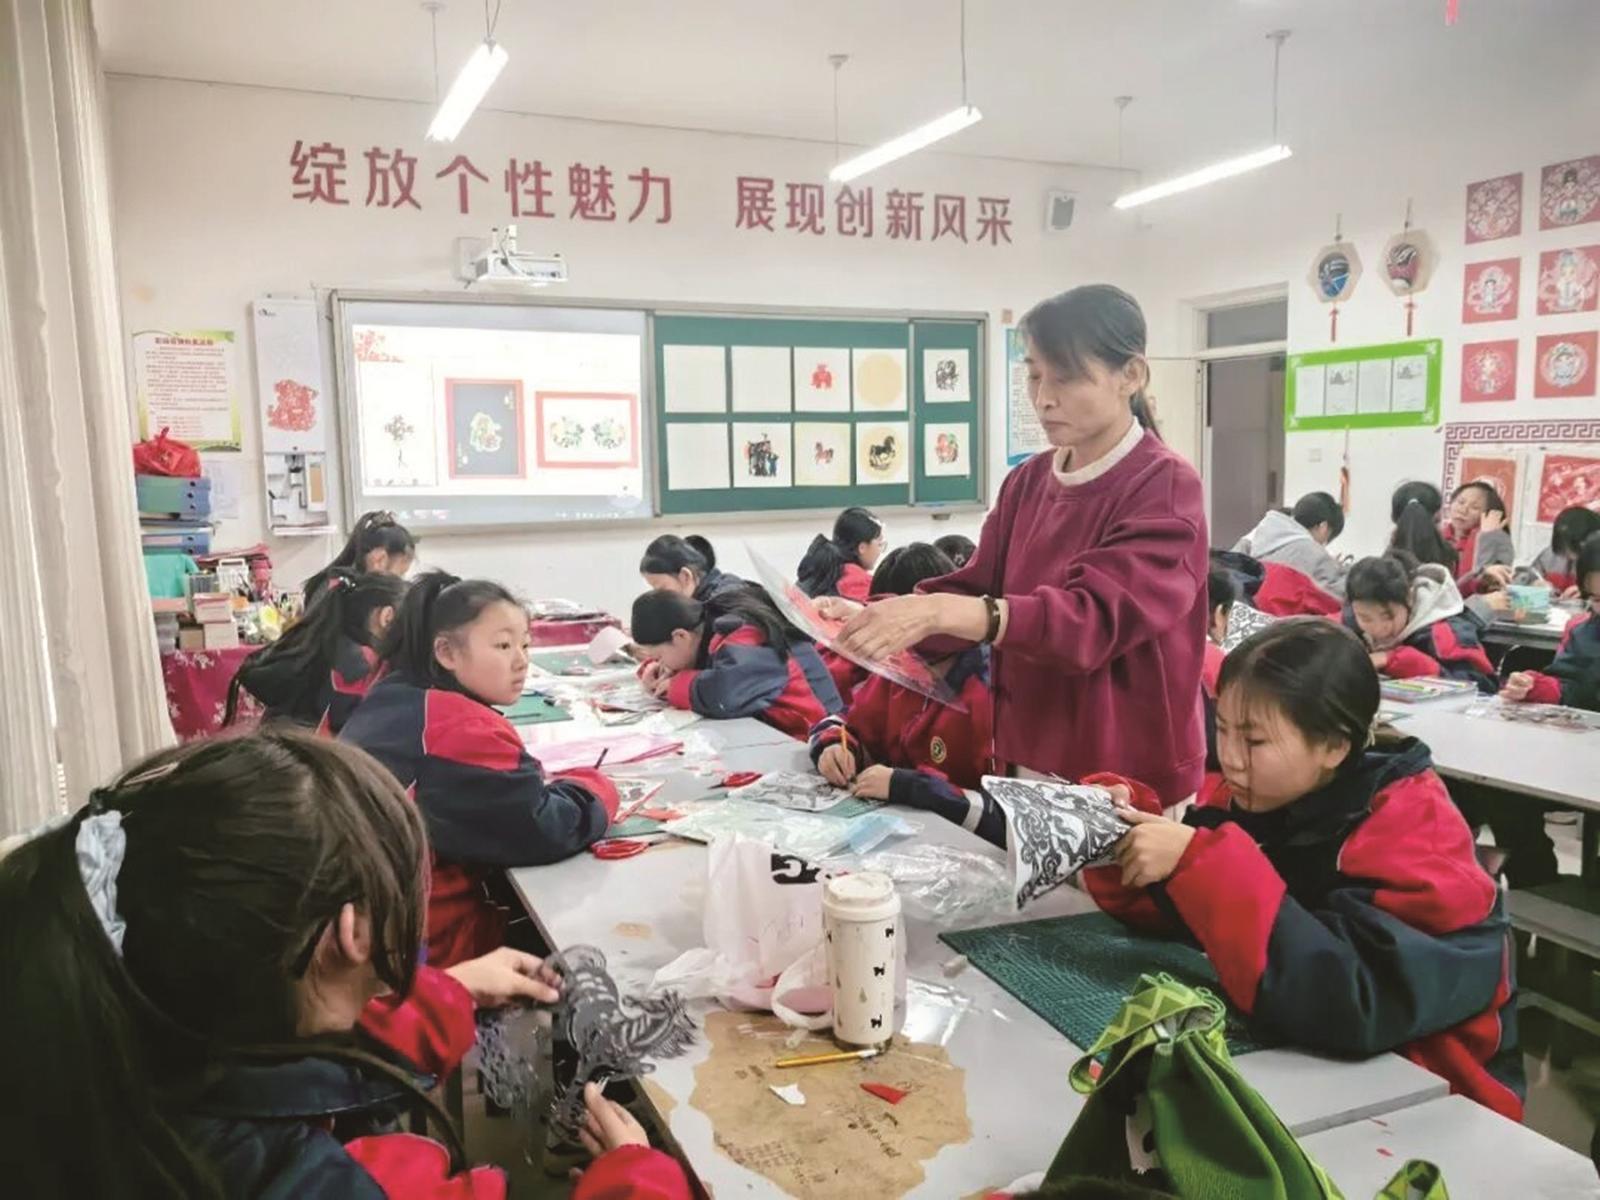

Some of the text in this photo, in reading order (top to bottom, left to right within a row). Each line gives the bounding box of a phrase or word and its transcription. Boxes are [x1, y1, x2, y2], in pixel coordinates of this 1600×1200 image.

[290, 140, 1013, 246] 绽放个性魅力 展现创新风采
